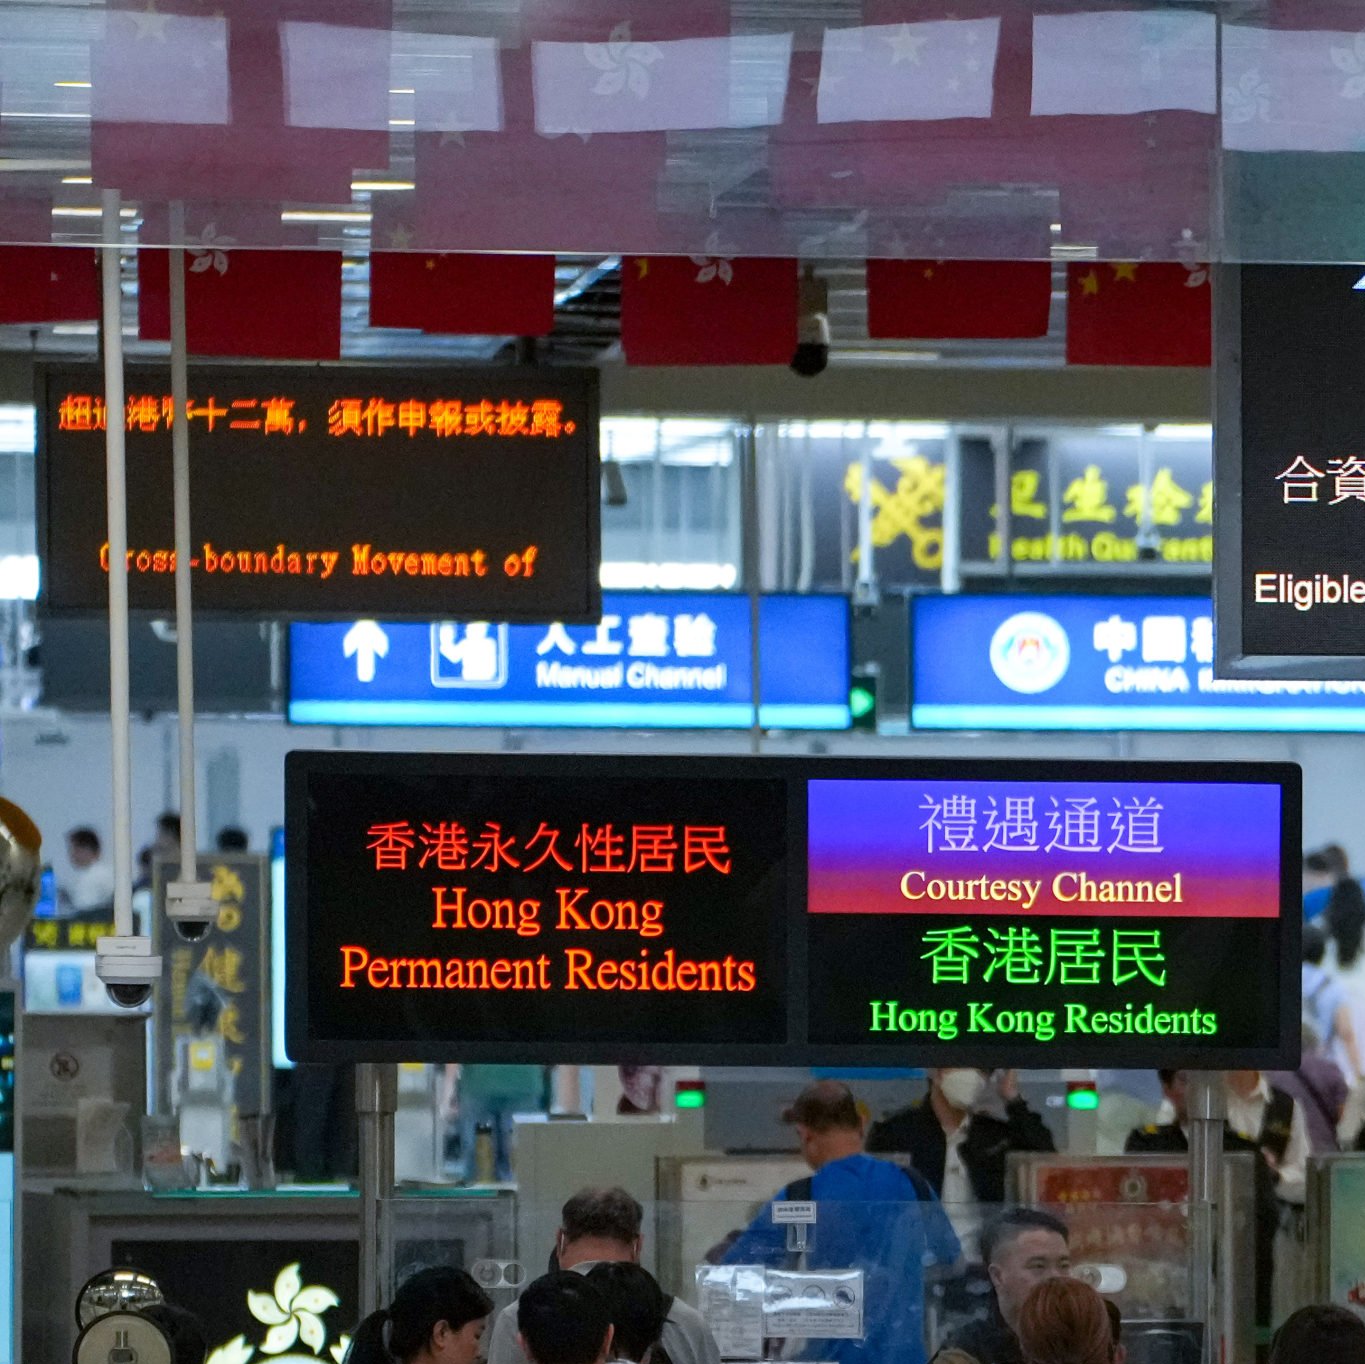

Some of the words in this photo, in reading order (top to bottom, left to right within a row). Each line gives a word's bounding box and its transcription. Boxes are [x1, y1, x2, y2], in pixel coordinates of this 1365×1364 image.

[351, 543, 489, 577] Movement
[503, 544, 539, 578] of
[535, 660, 625, 689] Manual
[626, 660, 728, 690] Channel
[365, 819, 734, 876] 香港永久性居民
[917, 792, 1165, 855] 禮遇通道
[431, 886, 541, 937] Hong
[555, 887, 665, 938] Kong
[899, 871, 1042, 910] Courtesy
[1051, 872, 1184, 904] Channel
[339, 945, 551, 991] Permanent
[564, 947, 758, 993] Residents
[919, 925, 1167, 988] 香港居民
[869, 1001, 958, 1040] Hong
[967, 1002, 1056, 1042] Kong
[1064, 1002, 1219, 1036] Residents
